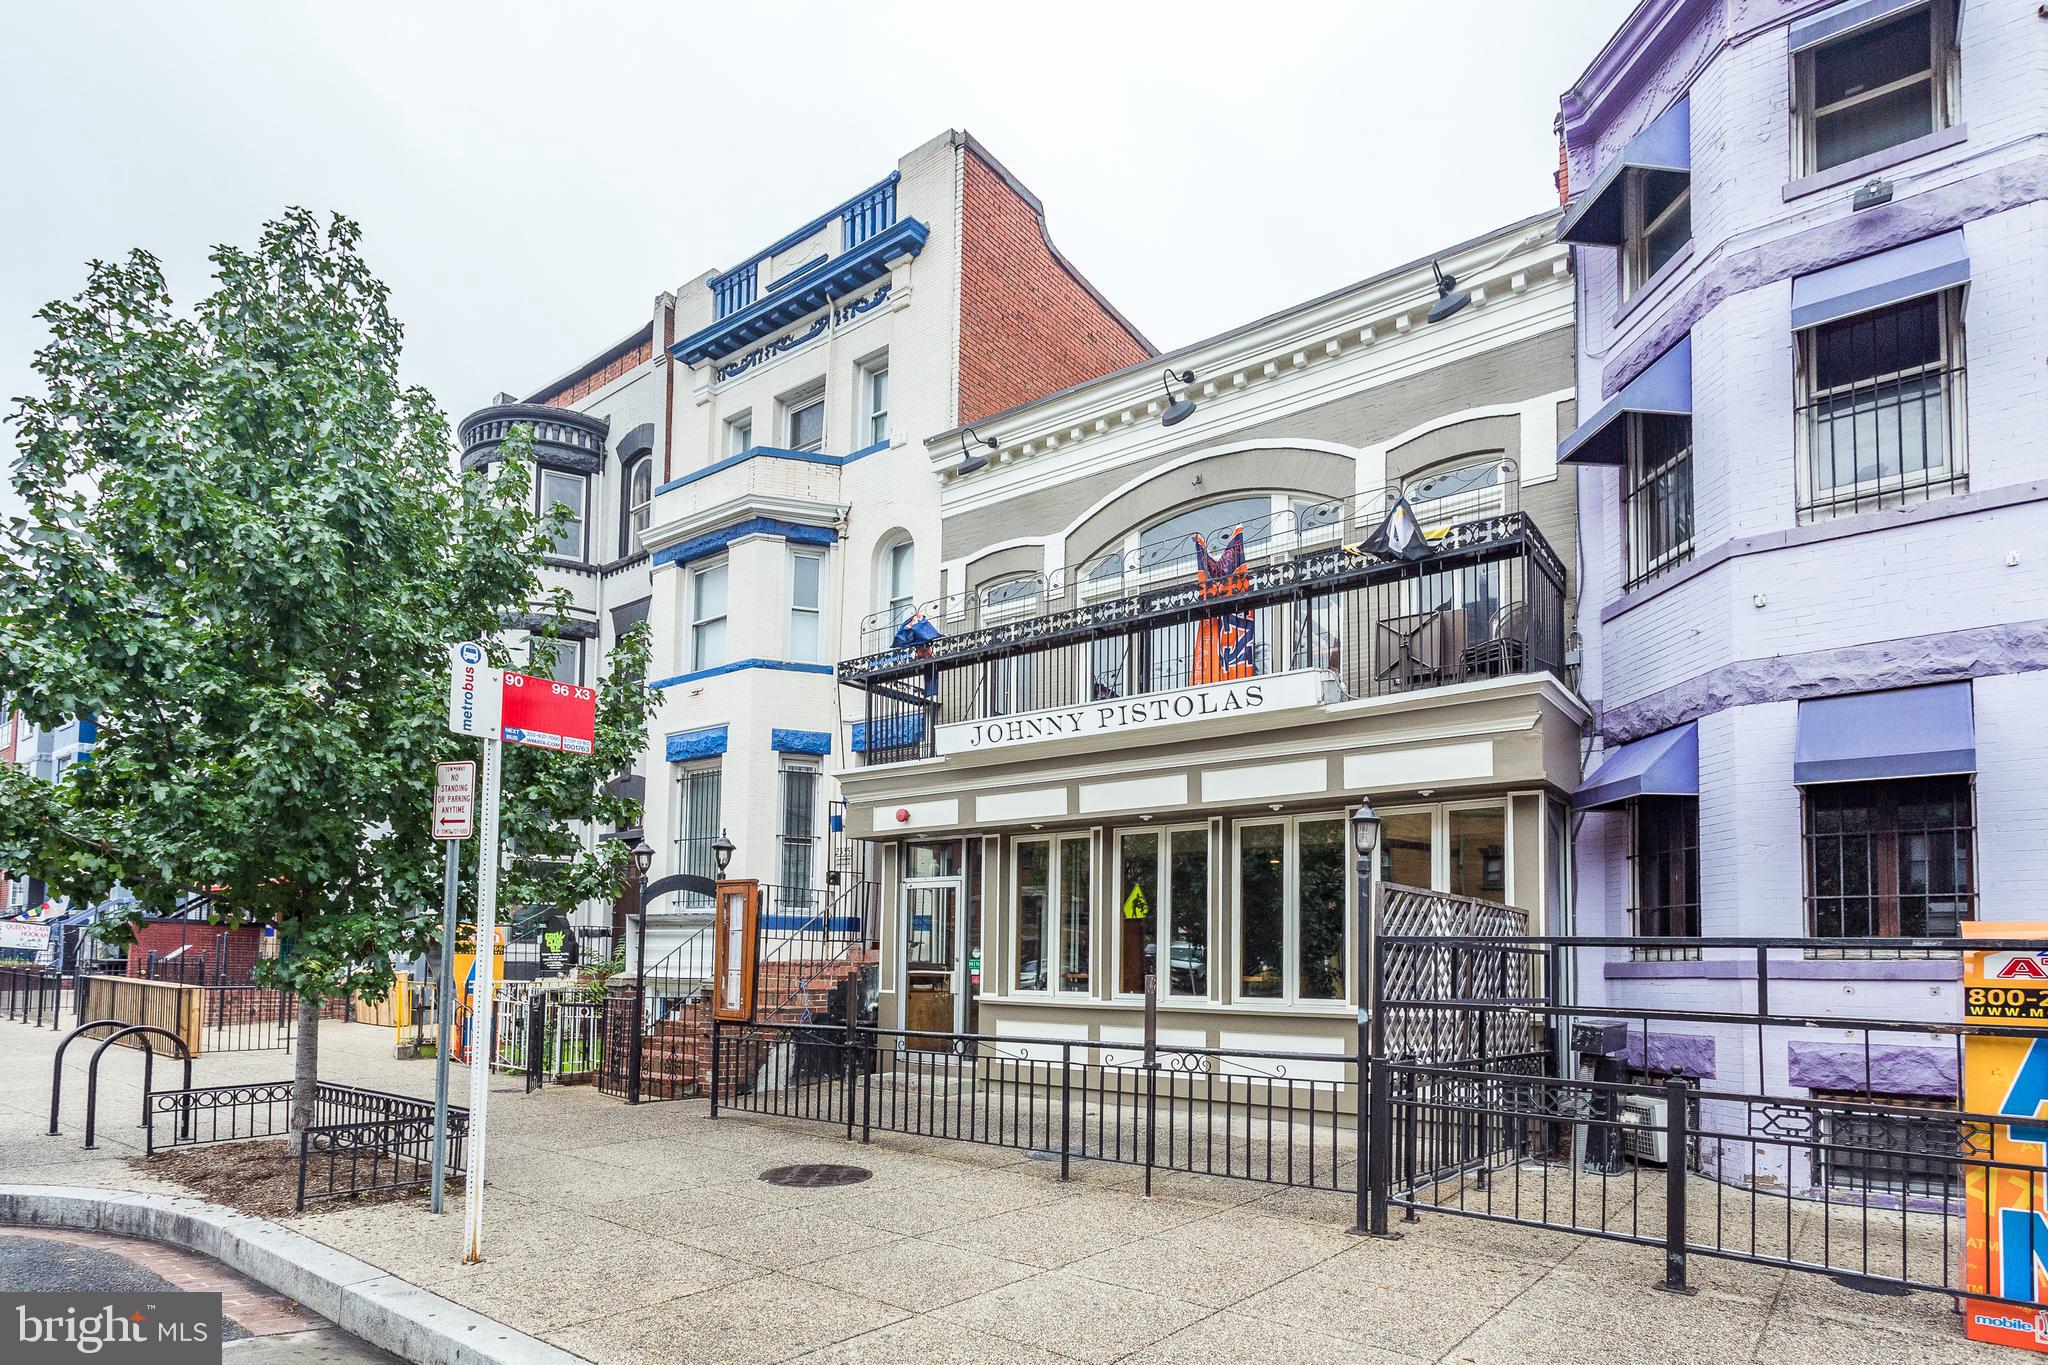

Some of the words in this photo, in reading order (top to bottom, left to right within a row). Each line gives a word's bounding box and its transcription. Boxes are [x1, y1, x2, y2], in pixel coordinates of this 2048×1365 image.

[505, 674, 524, 688] 90
[552, 684, 569, 697] 96
[574, 688, 591, 701] X3
[462, 666, 475, 732] metrobus
[970, 712, 1085, 747] JOHNNY
[1097, 685, 1264, 729] PISTOLAS
[505, 727, 520, 735] NEXT
[563, 743, 590, 753] 1001763
[450, 773, 459, 782] NO
[441, 784, 468, 792] STANDING
[437, 796, 446, 804] OR
[447, 795, 471, 803] PARKING
[441, 806, 466, 814] ANYTIME
[1975, 1315, 2033, 1331] mobile
